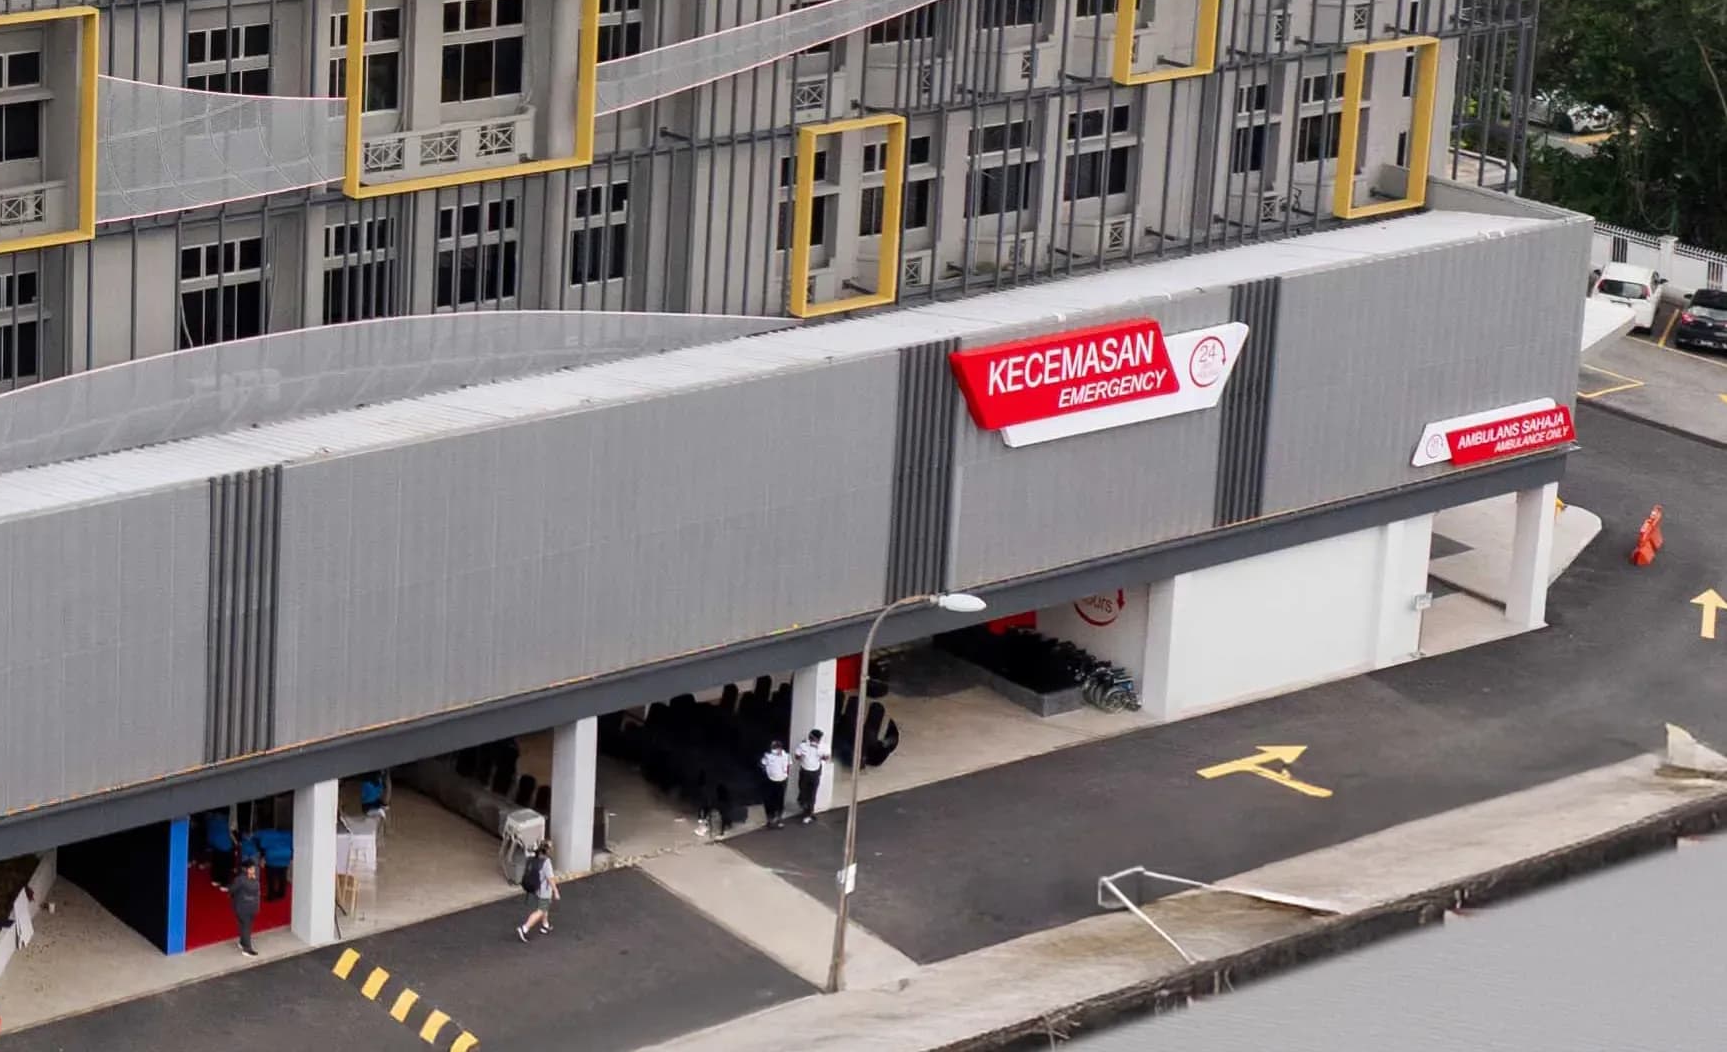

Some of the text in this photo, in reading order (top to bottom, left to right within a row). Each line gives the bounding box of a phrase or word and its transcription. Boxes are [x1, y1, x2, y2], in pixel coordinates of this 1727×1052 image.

[988, 330, 1154, 396] KECEMASAN
[1058, 368, 1167, 408] EMERGENCY
[1458, 425, 1519, 448] AMBULANS
[1521, 412, 1564, 432] SAHAJA
[1494, 425, 1569, 452] AMBULANCE ONLY
